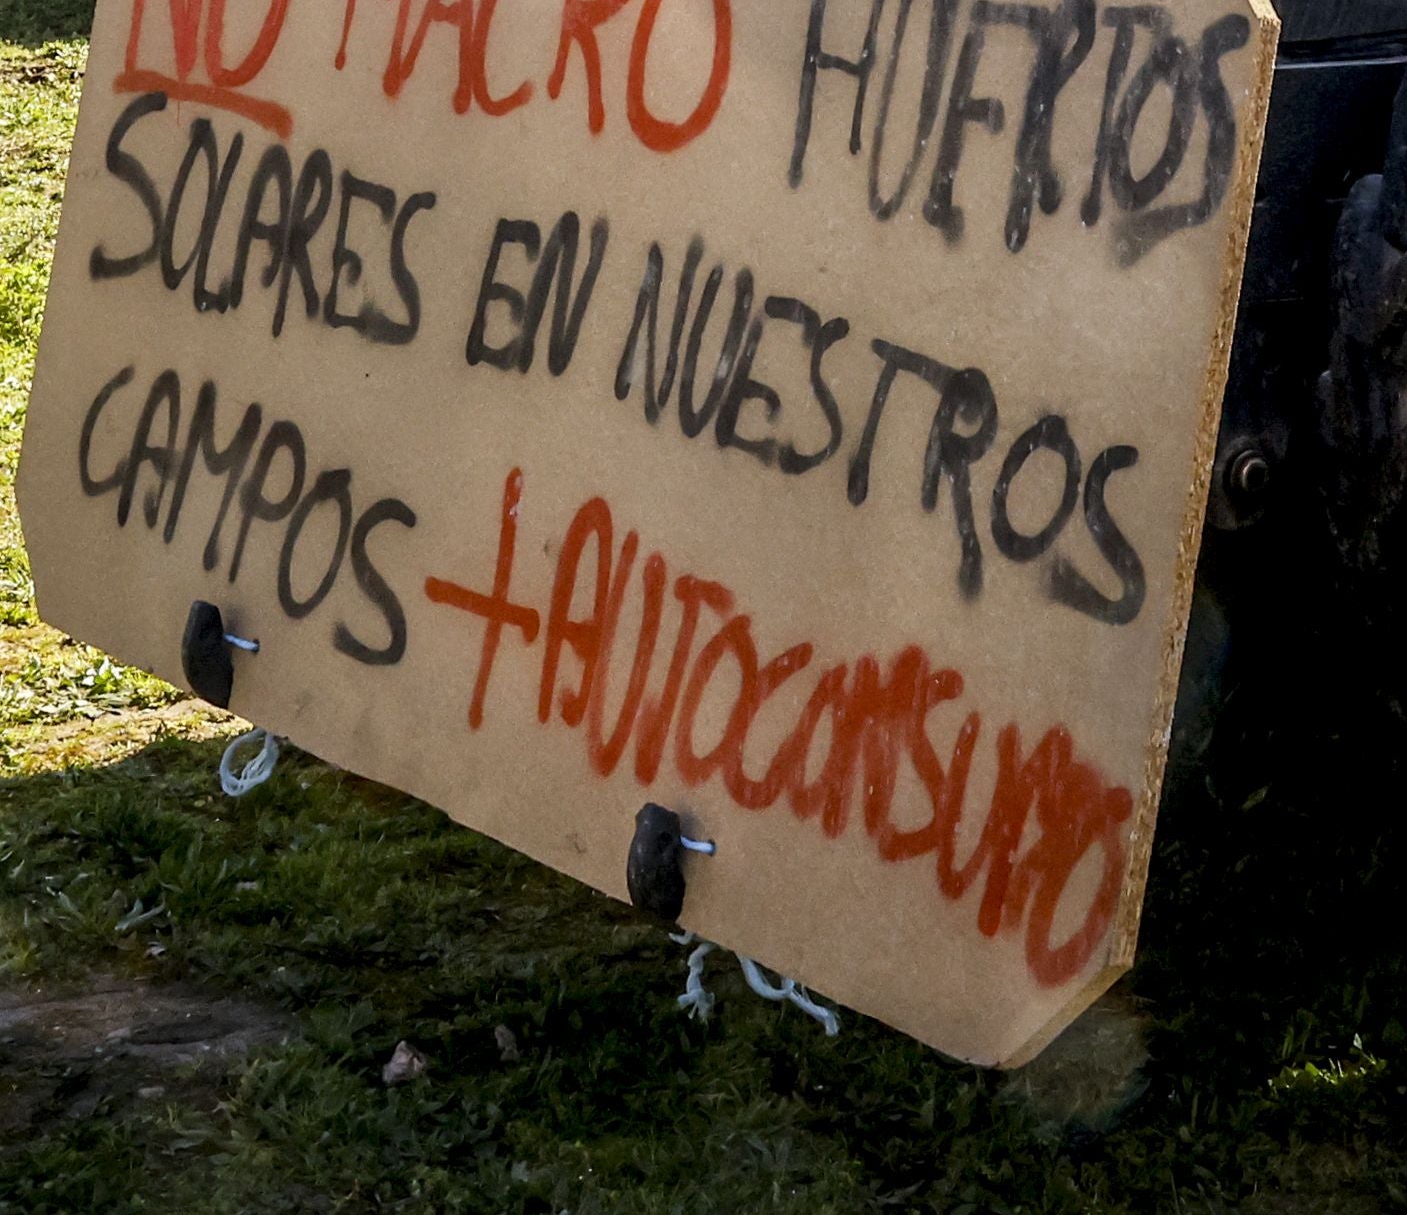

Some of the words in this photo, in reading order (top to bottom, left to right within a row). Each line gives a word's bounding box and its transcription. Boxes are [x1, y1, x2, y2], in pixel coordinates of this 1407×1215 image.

[78, 365, 417, 666] CAMPOS
[90, 90, 437, 346] SOLARES
[464, 210, 610, 376] EN
[614, 237, 1147, 626] NUESTROS
